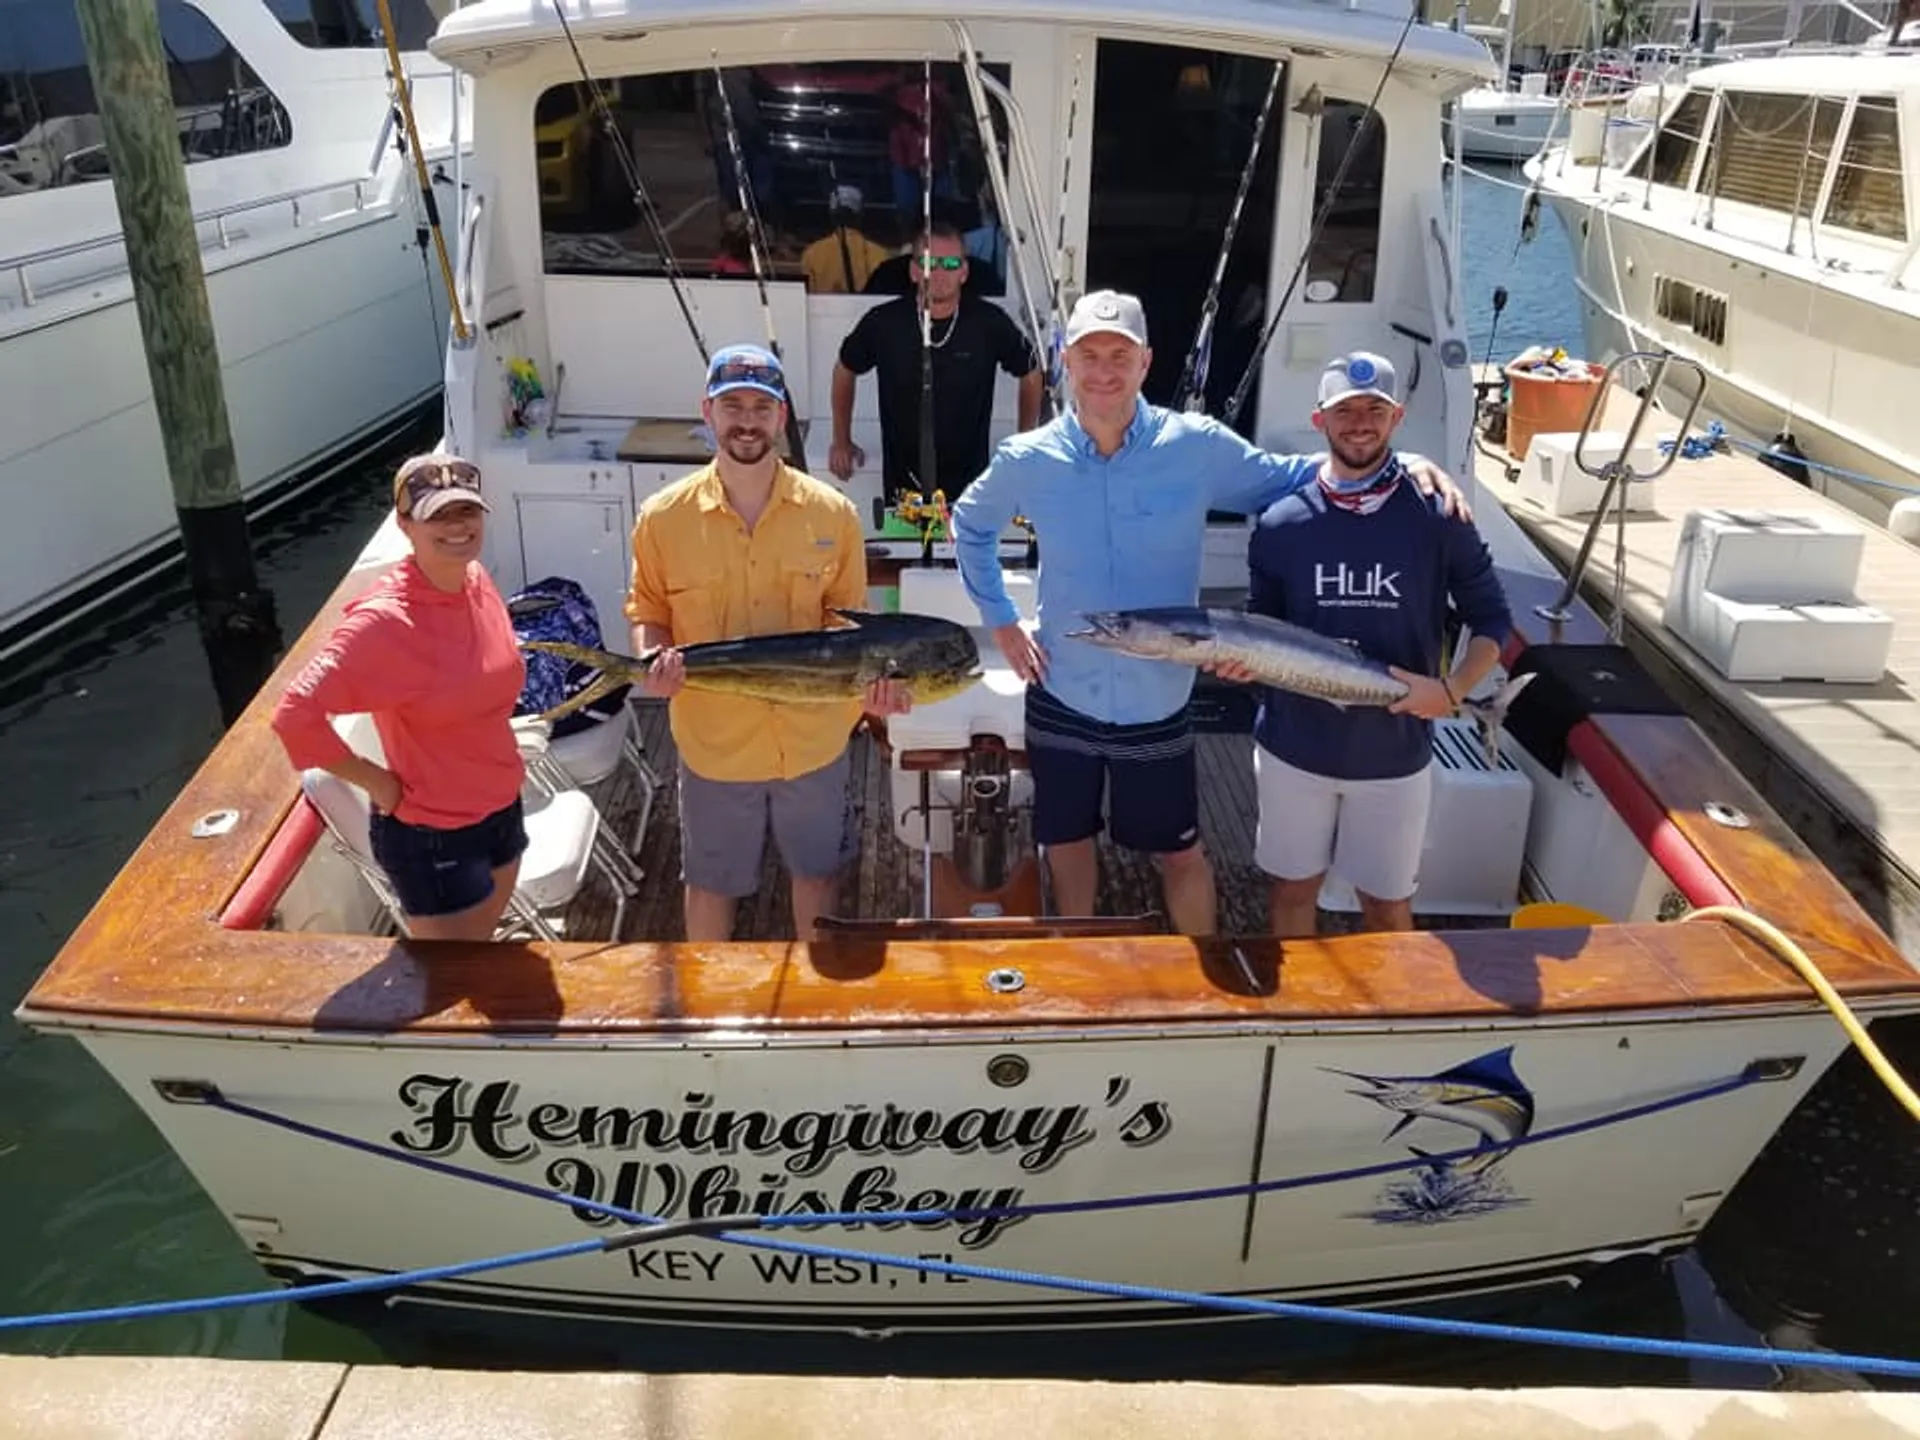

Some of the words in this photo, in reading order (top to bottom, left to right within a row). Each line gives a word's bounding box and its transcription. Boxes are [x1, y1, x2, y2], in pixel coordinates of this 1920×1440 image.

[1315, 562, 1401, 597] Huk
[389, 1074, 1172, 1174] Hemingway's
[545, 1157, 1031, 1250] Whiskey
[627, 1248, 725, 1281] KEY
[751, 1252, 897, 1289] WEST,
